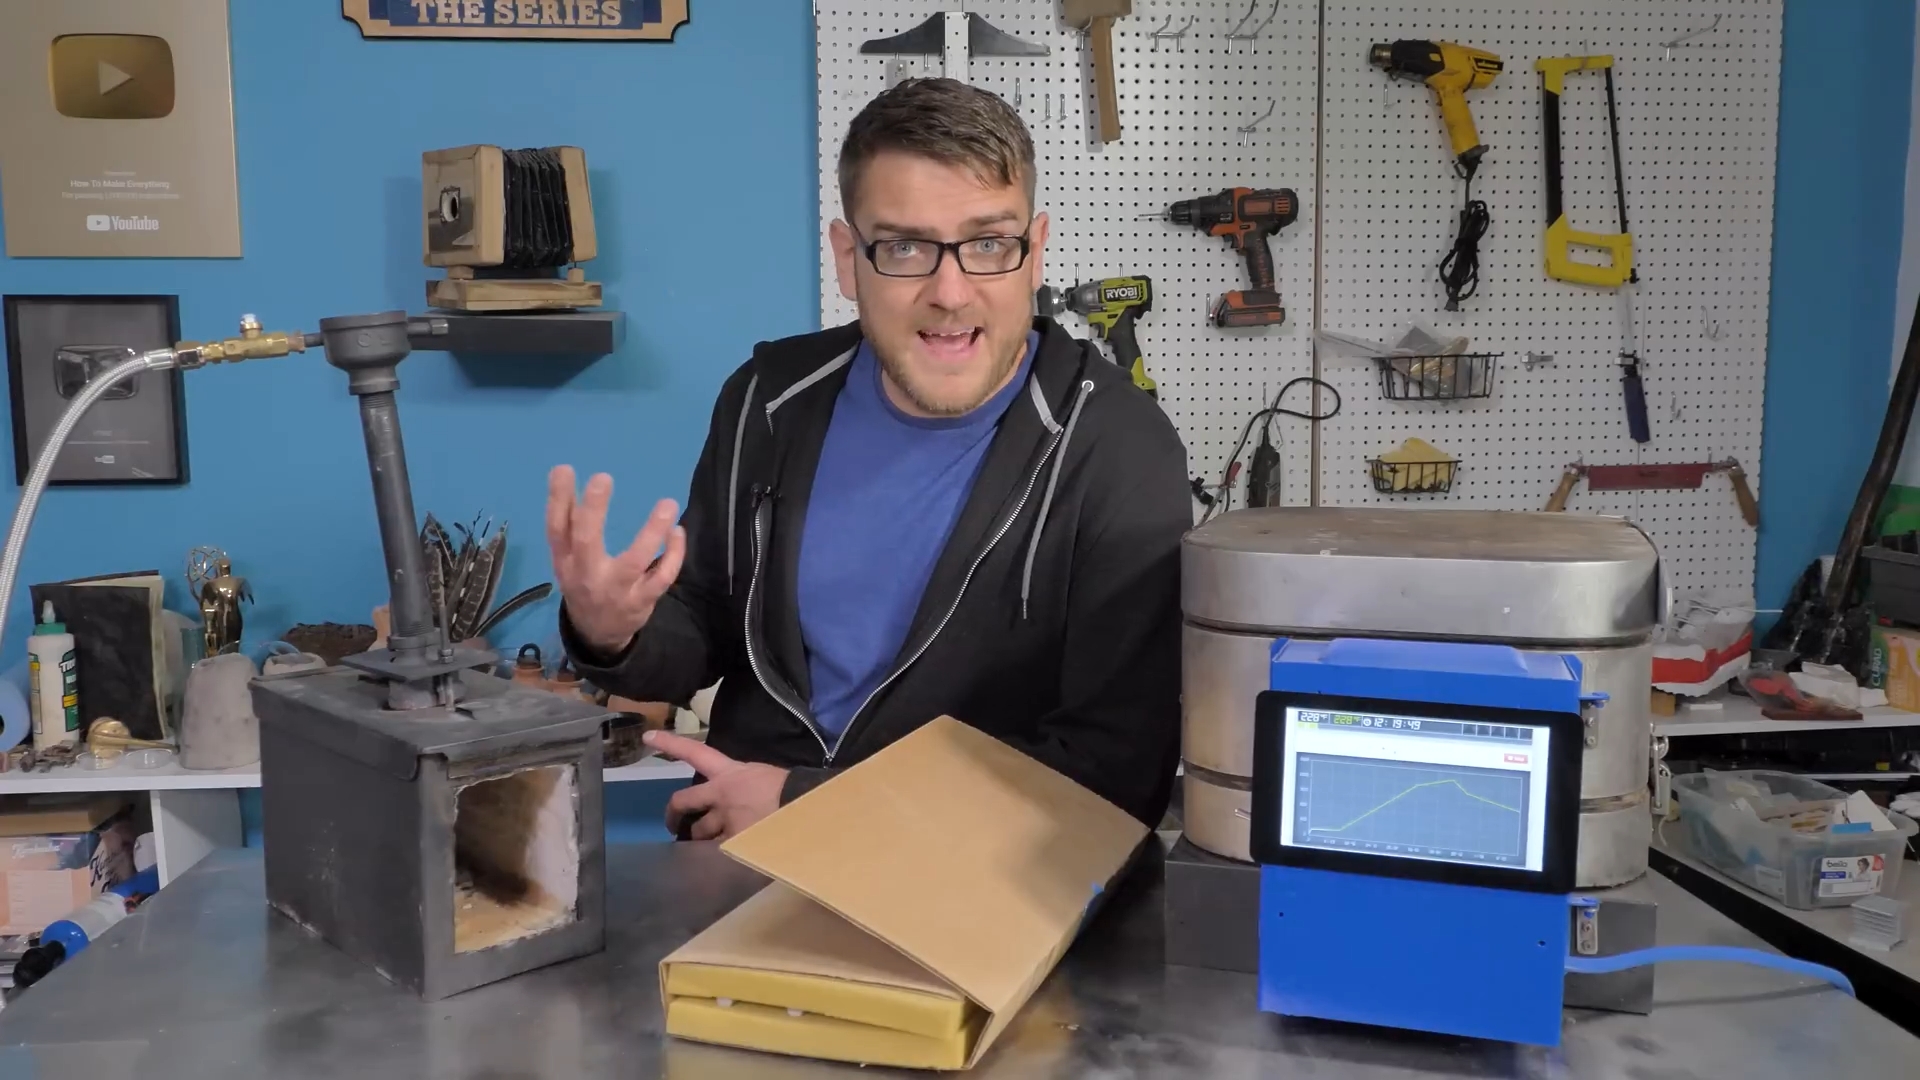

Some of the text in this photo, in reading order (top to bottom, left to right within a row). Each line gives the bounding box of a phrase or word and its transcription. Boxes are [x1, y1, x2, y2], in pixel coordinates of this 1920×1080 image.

[410, 0, 622, 26] THE SERIES
[70, 179, 170, 191] How To Make Everything
[111, 215, 160, 231] YouTube
[1105, 286, 1138, 299] RYOBI
